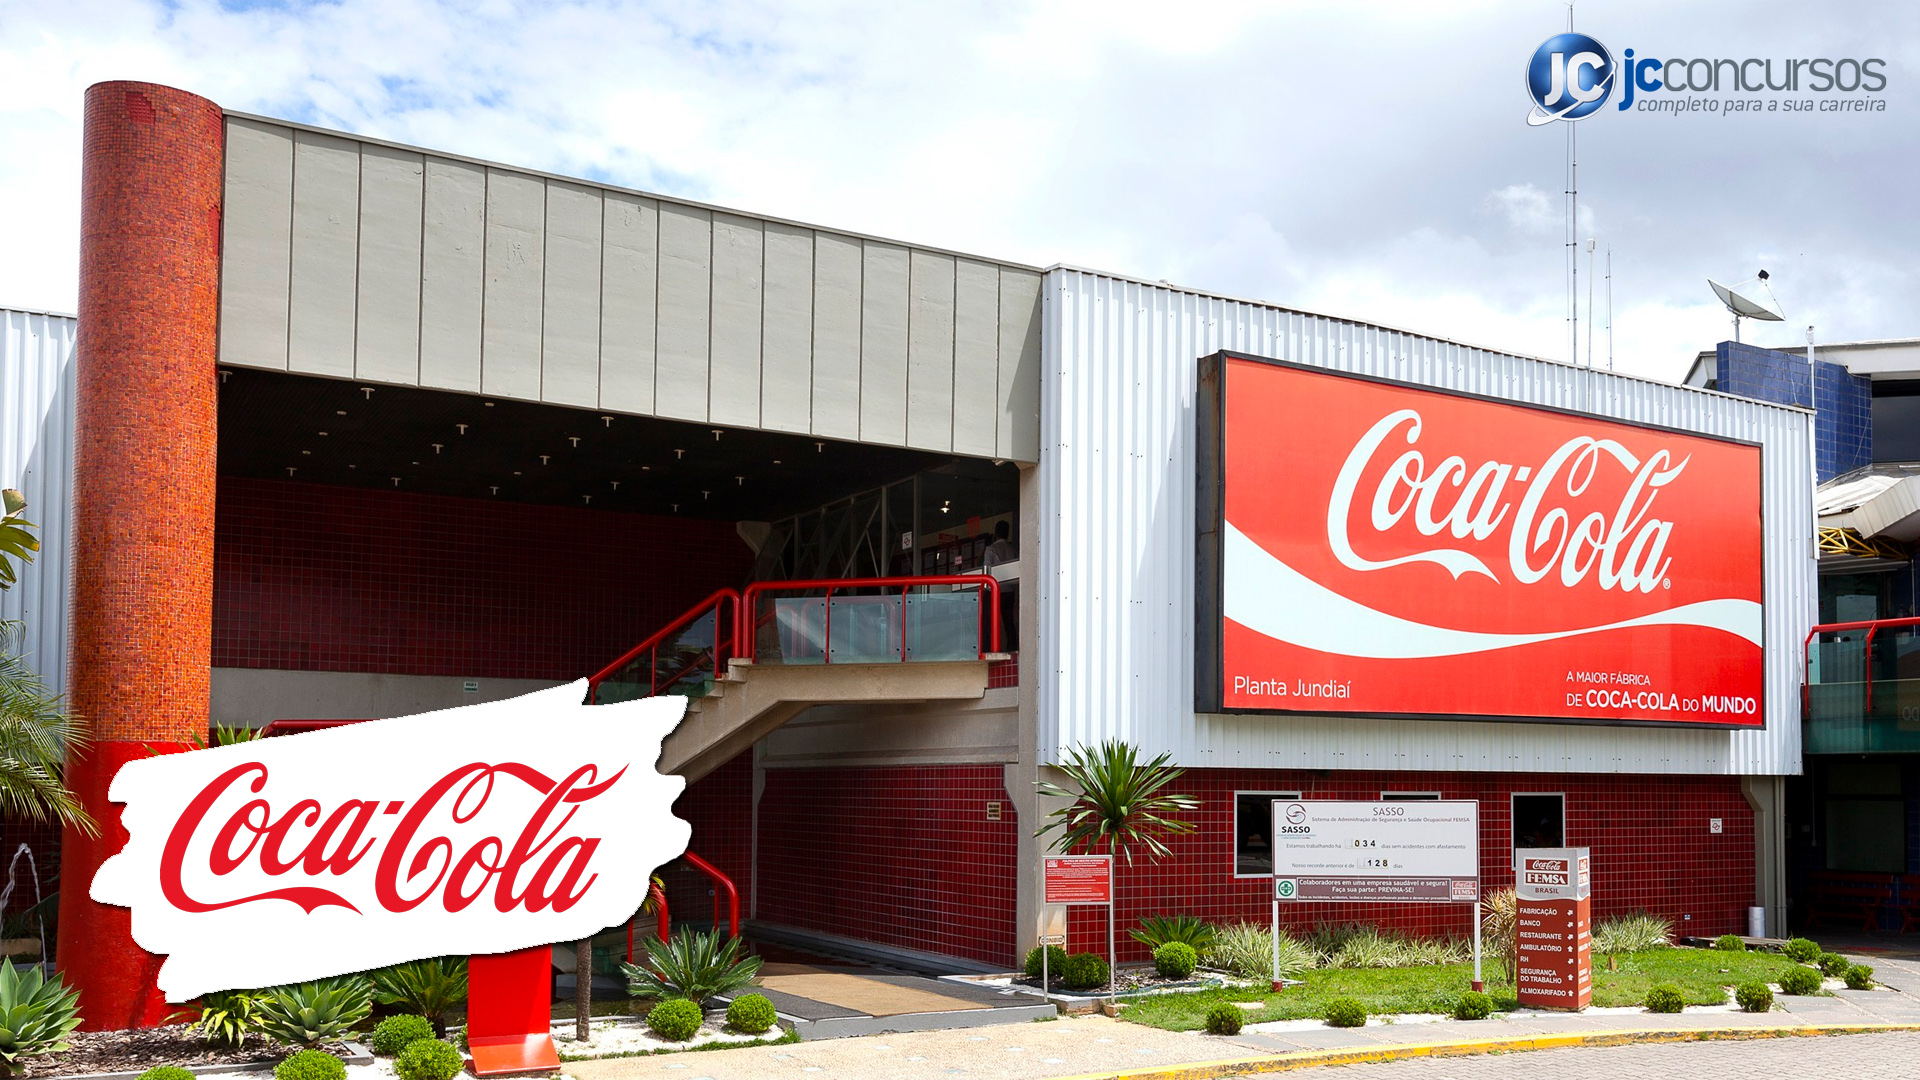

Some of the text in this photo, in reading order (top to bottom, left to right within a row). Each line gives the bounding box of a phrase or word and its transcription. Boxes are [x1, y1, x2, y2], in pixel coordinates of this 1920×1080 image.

[1327, 409, 1692, 593] Coca-Cola
[1566, 670, 1651, 686] A MAIOR FÁBRICA
[1234, 675, 1351, 698] Planta Jundiaí
[1566, 689, 1757, 715] DE COCA-COLA DO MUNDO
[1372, 806, 1405, 816] SASSO
[1281, 826, 1311, 834] SASSO
[1527, 873, 1566, 884] FEMSA
[1425, 880, 1448, 888] segura!
[1331, 886, 1346, 894] Faça
[1519, 907, 1558, 916] FABRICAÇÃO
[1519, 919, 1541, 927] BANCO
[1520, 931, 1562, 940] RESTAURANTE
[1520, 943, 1562, 953] AMBULATÓRIO
[1520, 967, 1556, 976] SEGURANÇA
[1530, 976, 1562, 984] TRABALHO
[1520, 987, 1566, 997] ALMOXARIFADO
